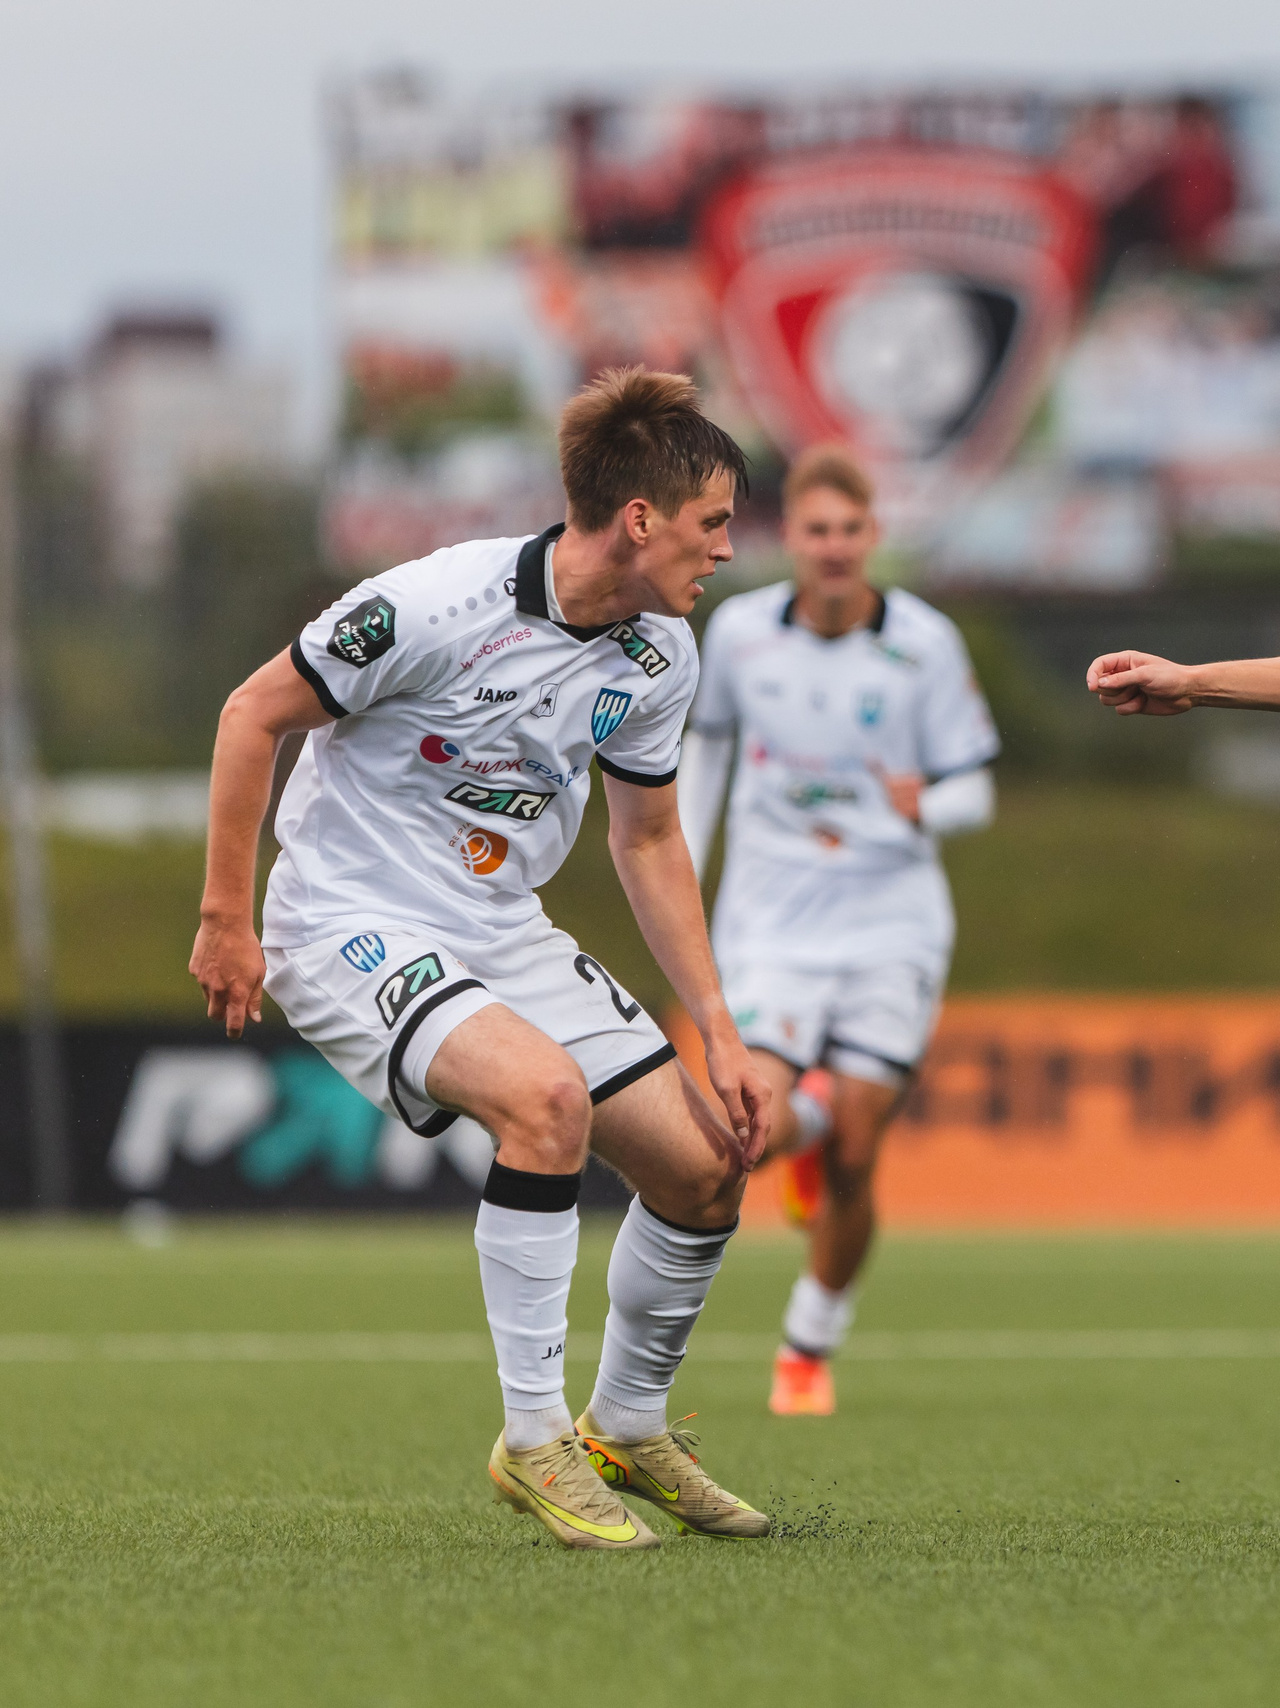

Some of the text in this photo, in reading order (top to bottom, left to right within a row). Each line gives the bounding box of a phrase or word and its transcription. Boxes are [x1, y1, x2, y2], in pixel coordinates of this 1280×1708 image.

[338, 620, 368, 662] PARI
[460, 627, 533, 669] wiberries
[610, 622, 668, 677] PARI
[473, 686, 518, 703] JAKO
[460, 757, 579, 788] НИЖФА
[450, 783, 551, 818] PARI
